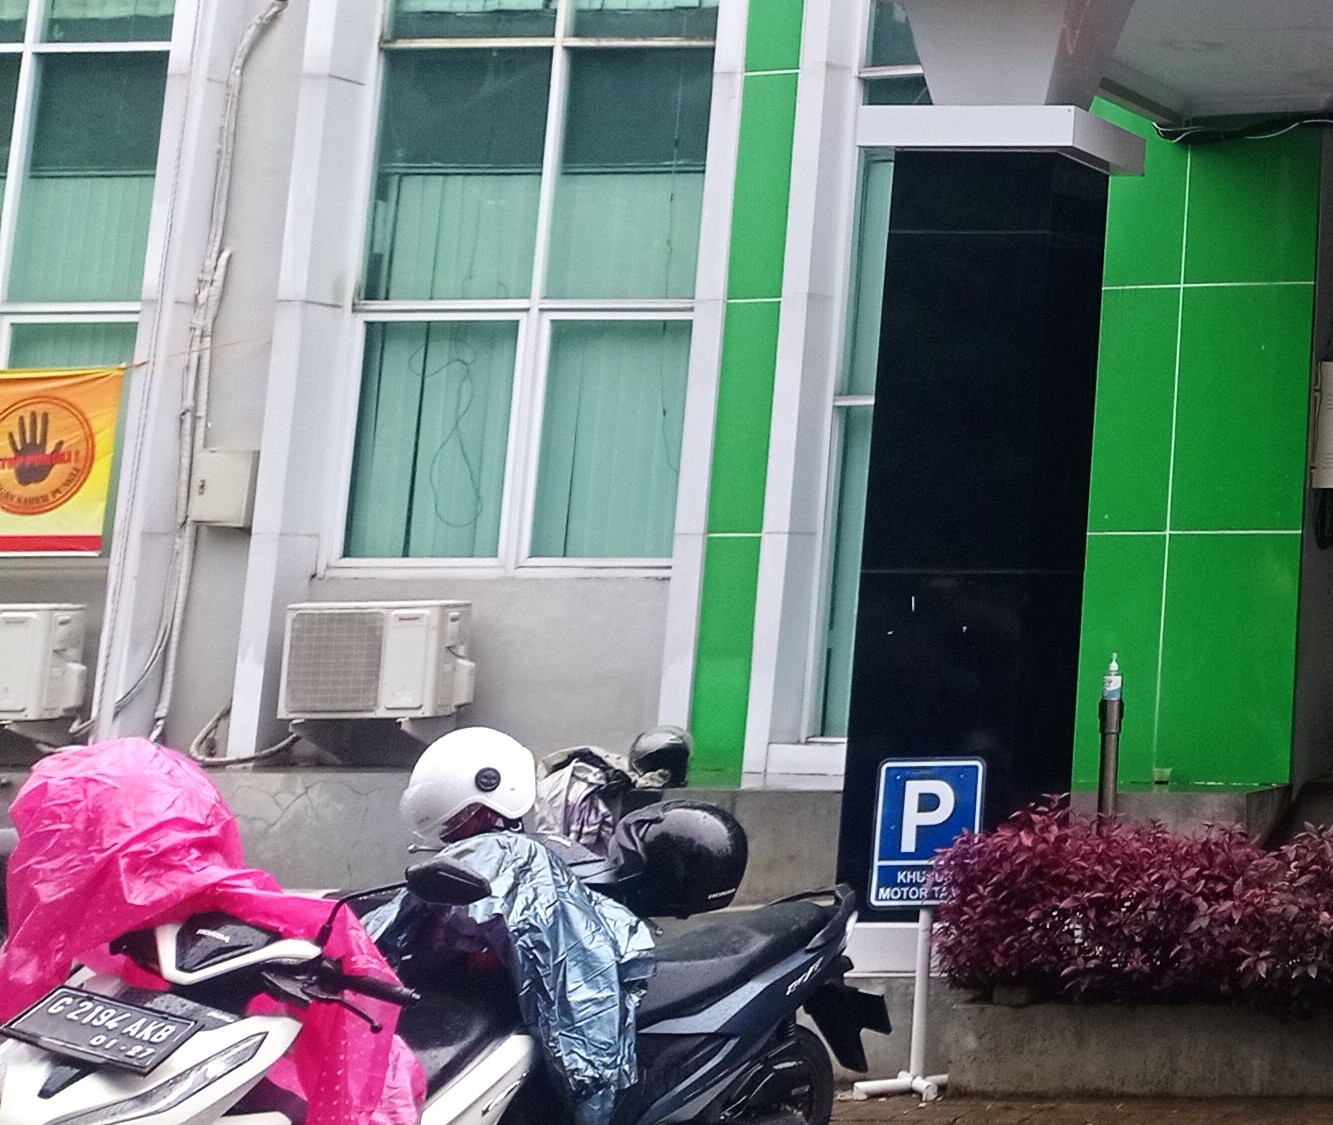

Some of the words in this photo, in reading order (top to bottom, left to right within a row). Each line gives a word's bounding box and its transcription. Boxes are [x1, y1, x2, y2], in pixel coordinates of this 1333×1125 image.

[900, 779, 955, 853] P
[878, 886, 928, 900] MOTOR
[47, 996, 73, 1015] G
